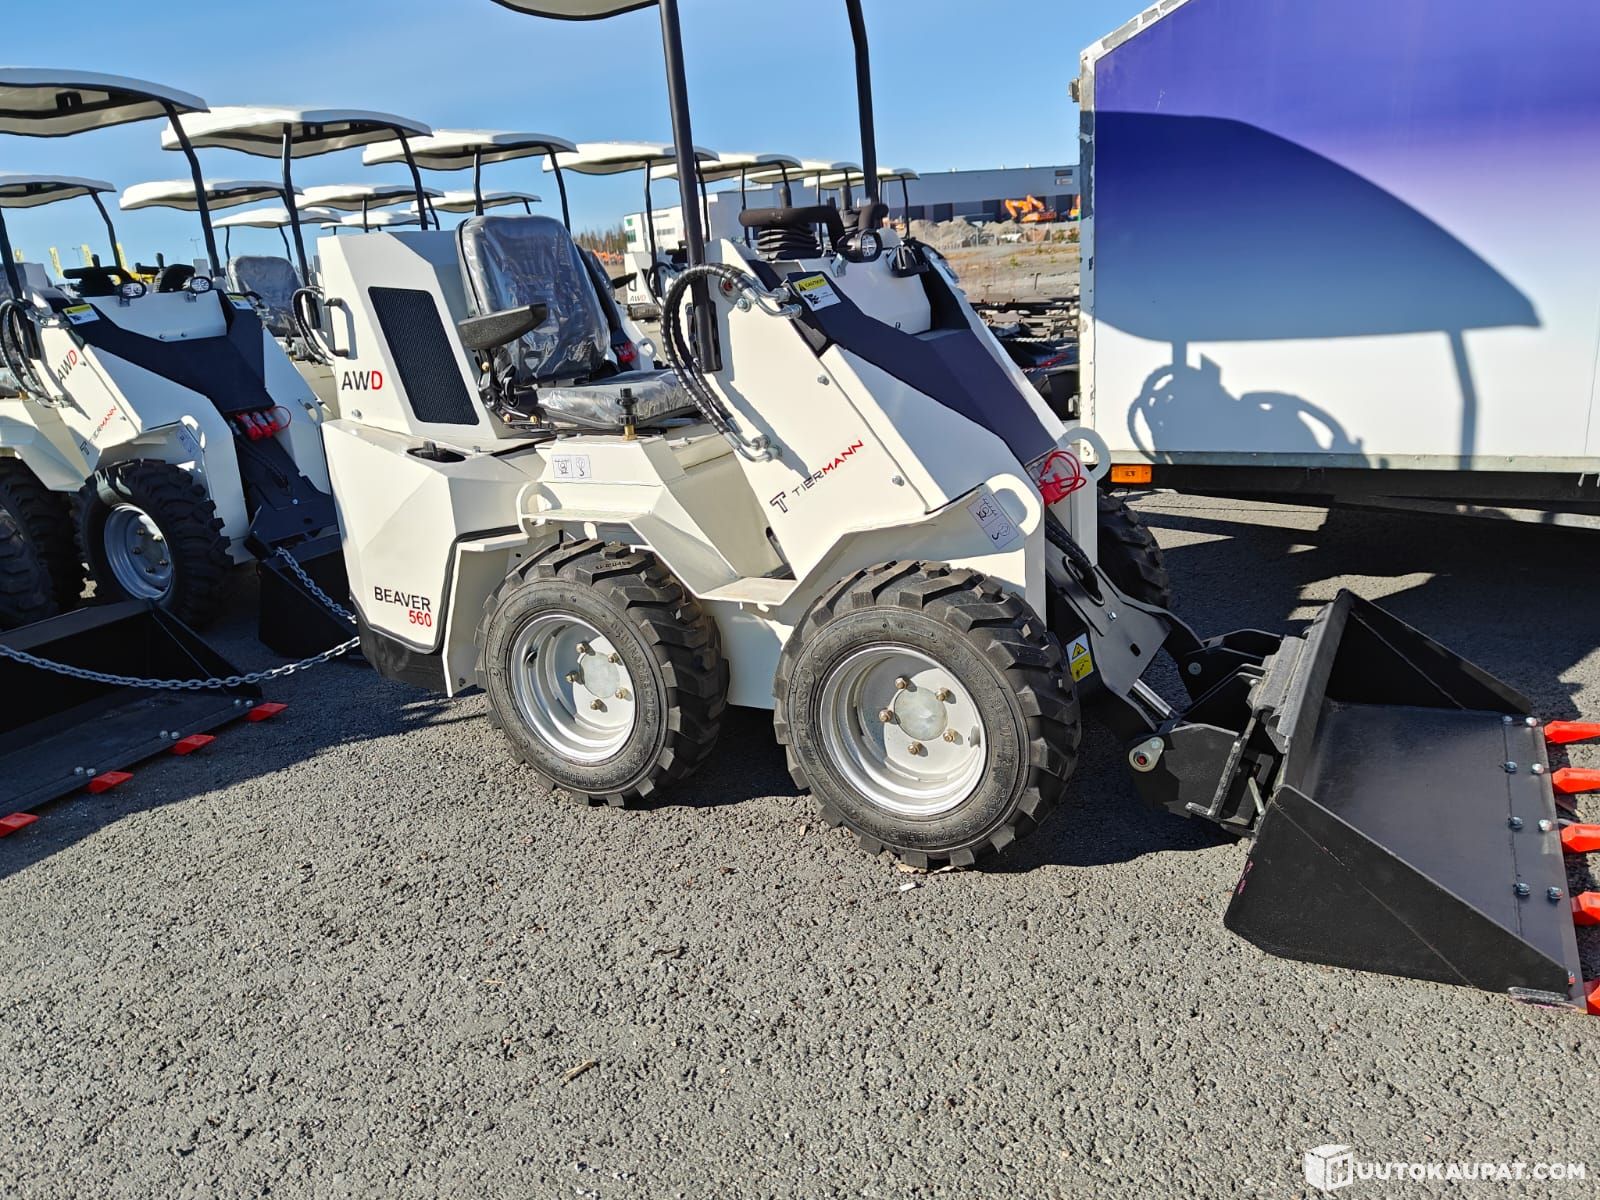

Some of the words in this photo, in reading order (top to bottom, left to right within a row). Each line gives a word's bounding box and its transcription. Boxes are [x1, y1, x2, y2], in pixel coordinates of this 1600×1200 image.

[630, 294, 647, 302] AWD
[57, 349, 77, 383] AWD
[341, 370, 383, 390] AWD
[791, 439, 864, 496] TIERMANN
[374, 585, 432, 613] BEAVER
[408, 609, 432, 627] 560
